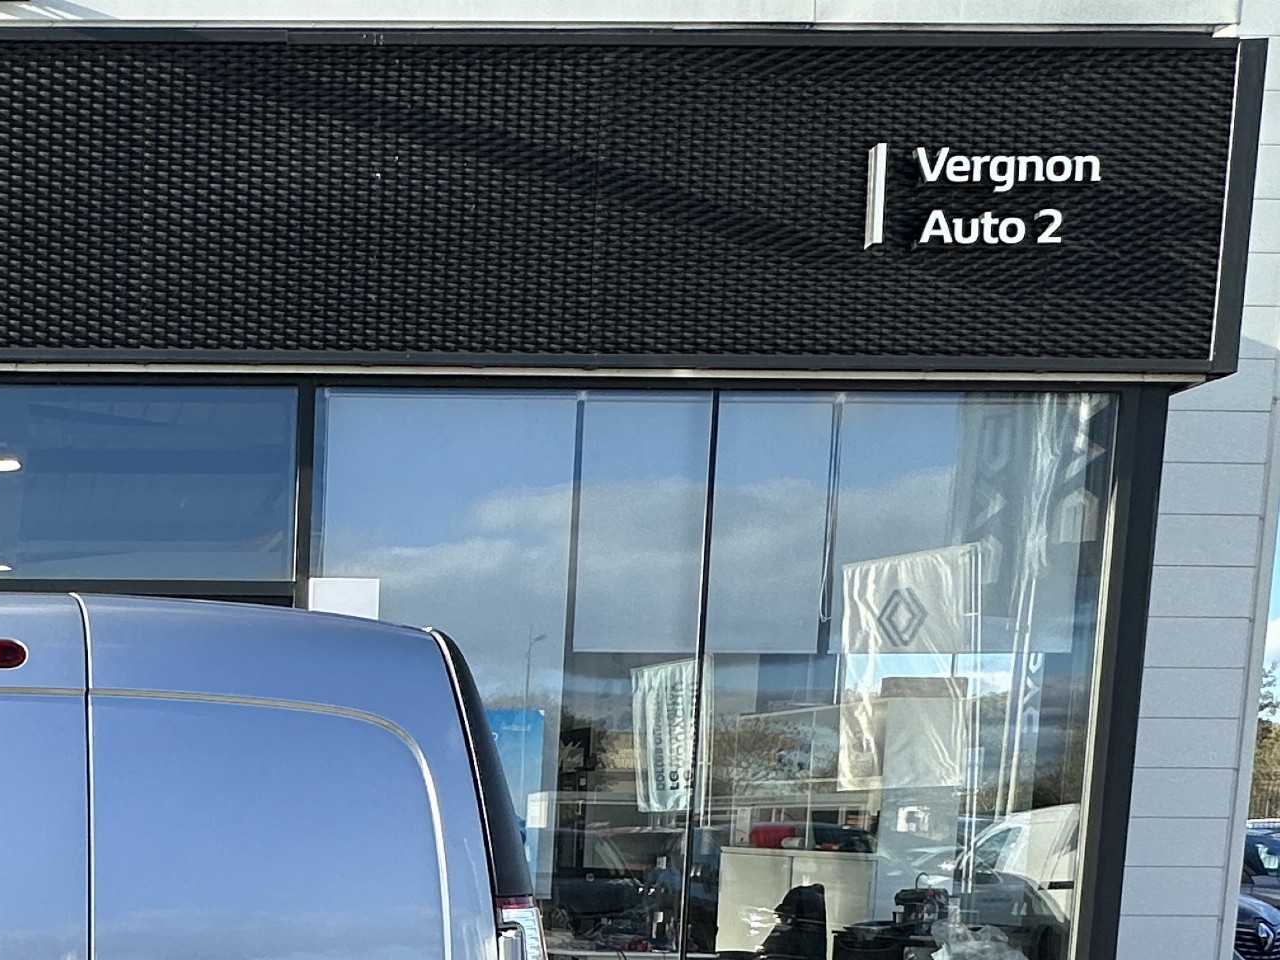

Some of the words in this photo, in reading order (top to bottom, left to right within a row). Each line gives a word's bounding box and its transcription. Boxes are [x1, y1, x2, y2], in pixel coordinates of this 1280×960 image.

[913, 146, 1102, 193] Vergnon
[918, 208, 1026, 245] Auto
[1033, 208, 1063, 244] 2
